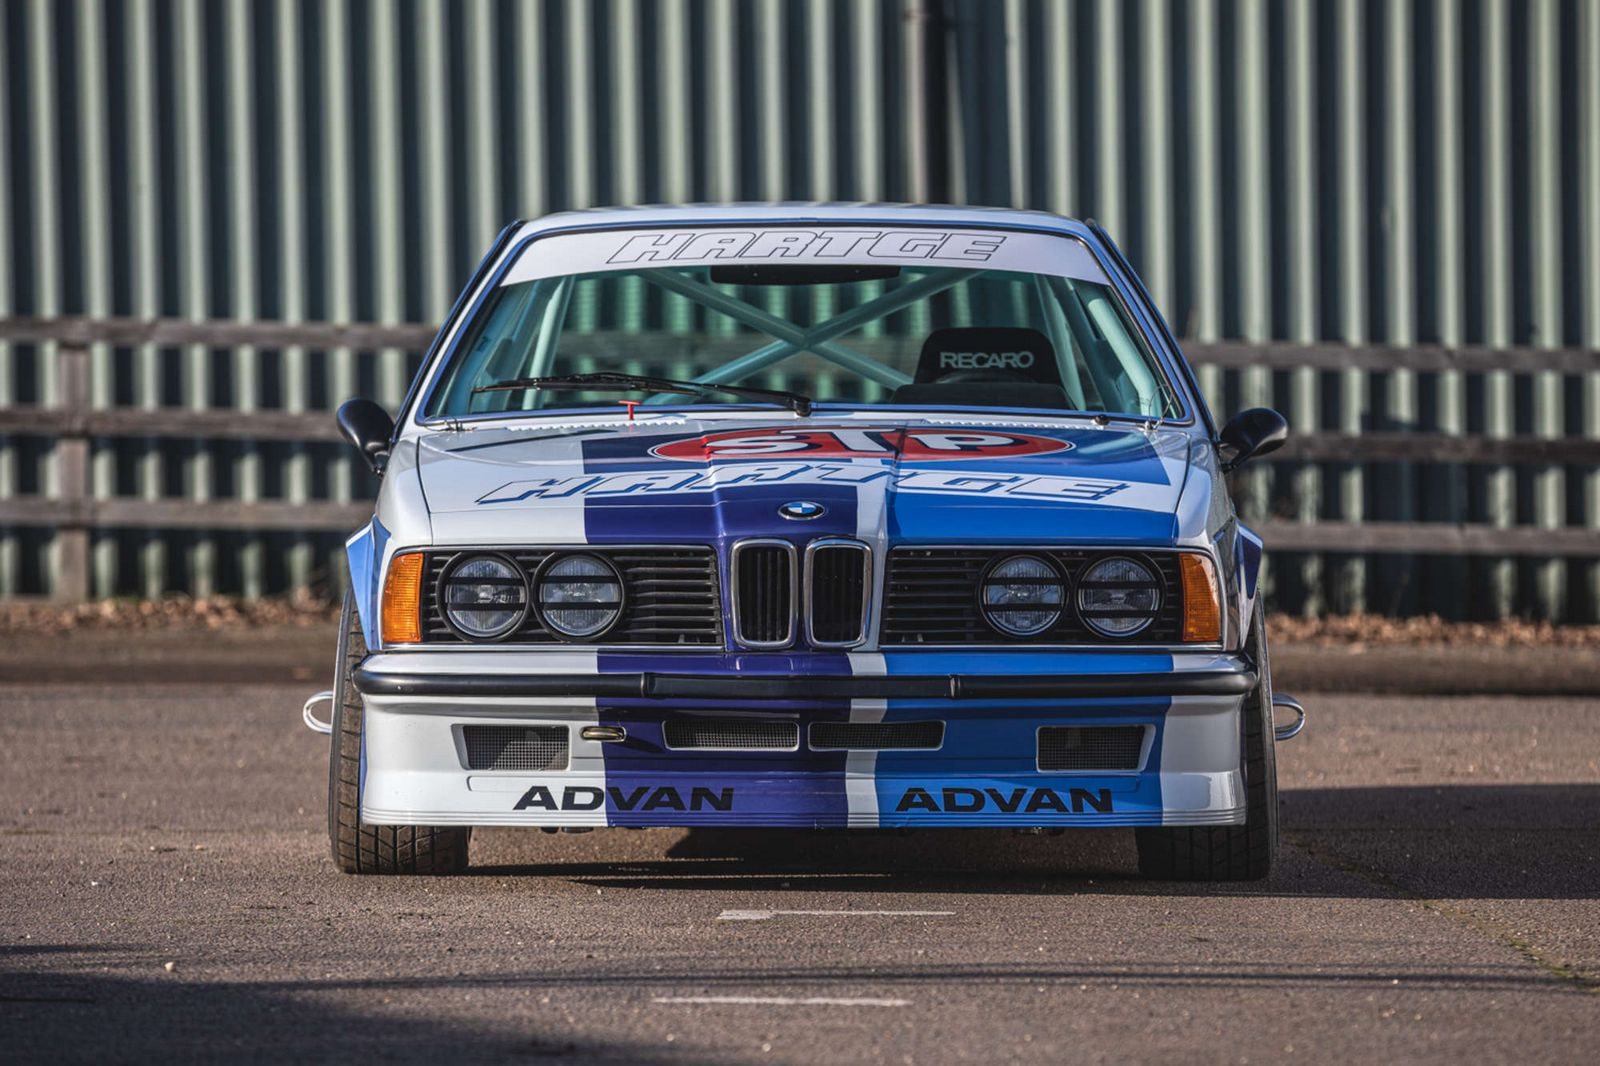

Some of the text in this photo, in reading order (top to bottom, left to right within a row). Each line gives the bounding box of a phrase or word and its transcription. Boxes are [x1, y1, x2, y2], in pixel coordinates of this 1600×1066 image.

[606, 231, 1007, 264] HARTGE
[940, 351, 1034, 368] RECARO
[704, 428, 1018, 455] STP
[475, 464, 1129, 504] HARTGE
[513, 785, 734, 811] ADVAN
[895, 787, 1114, 813] ADVAN
